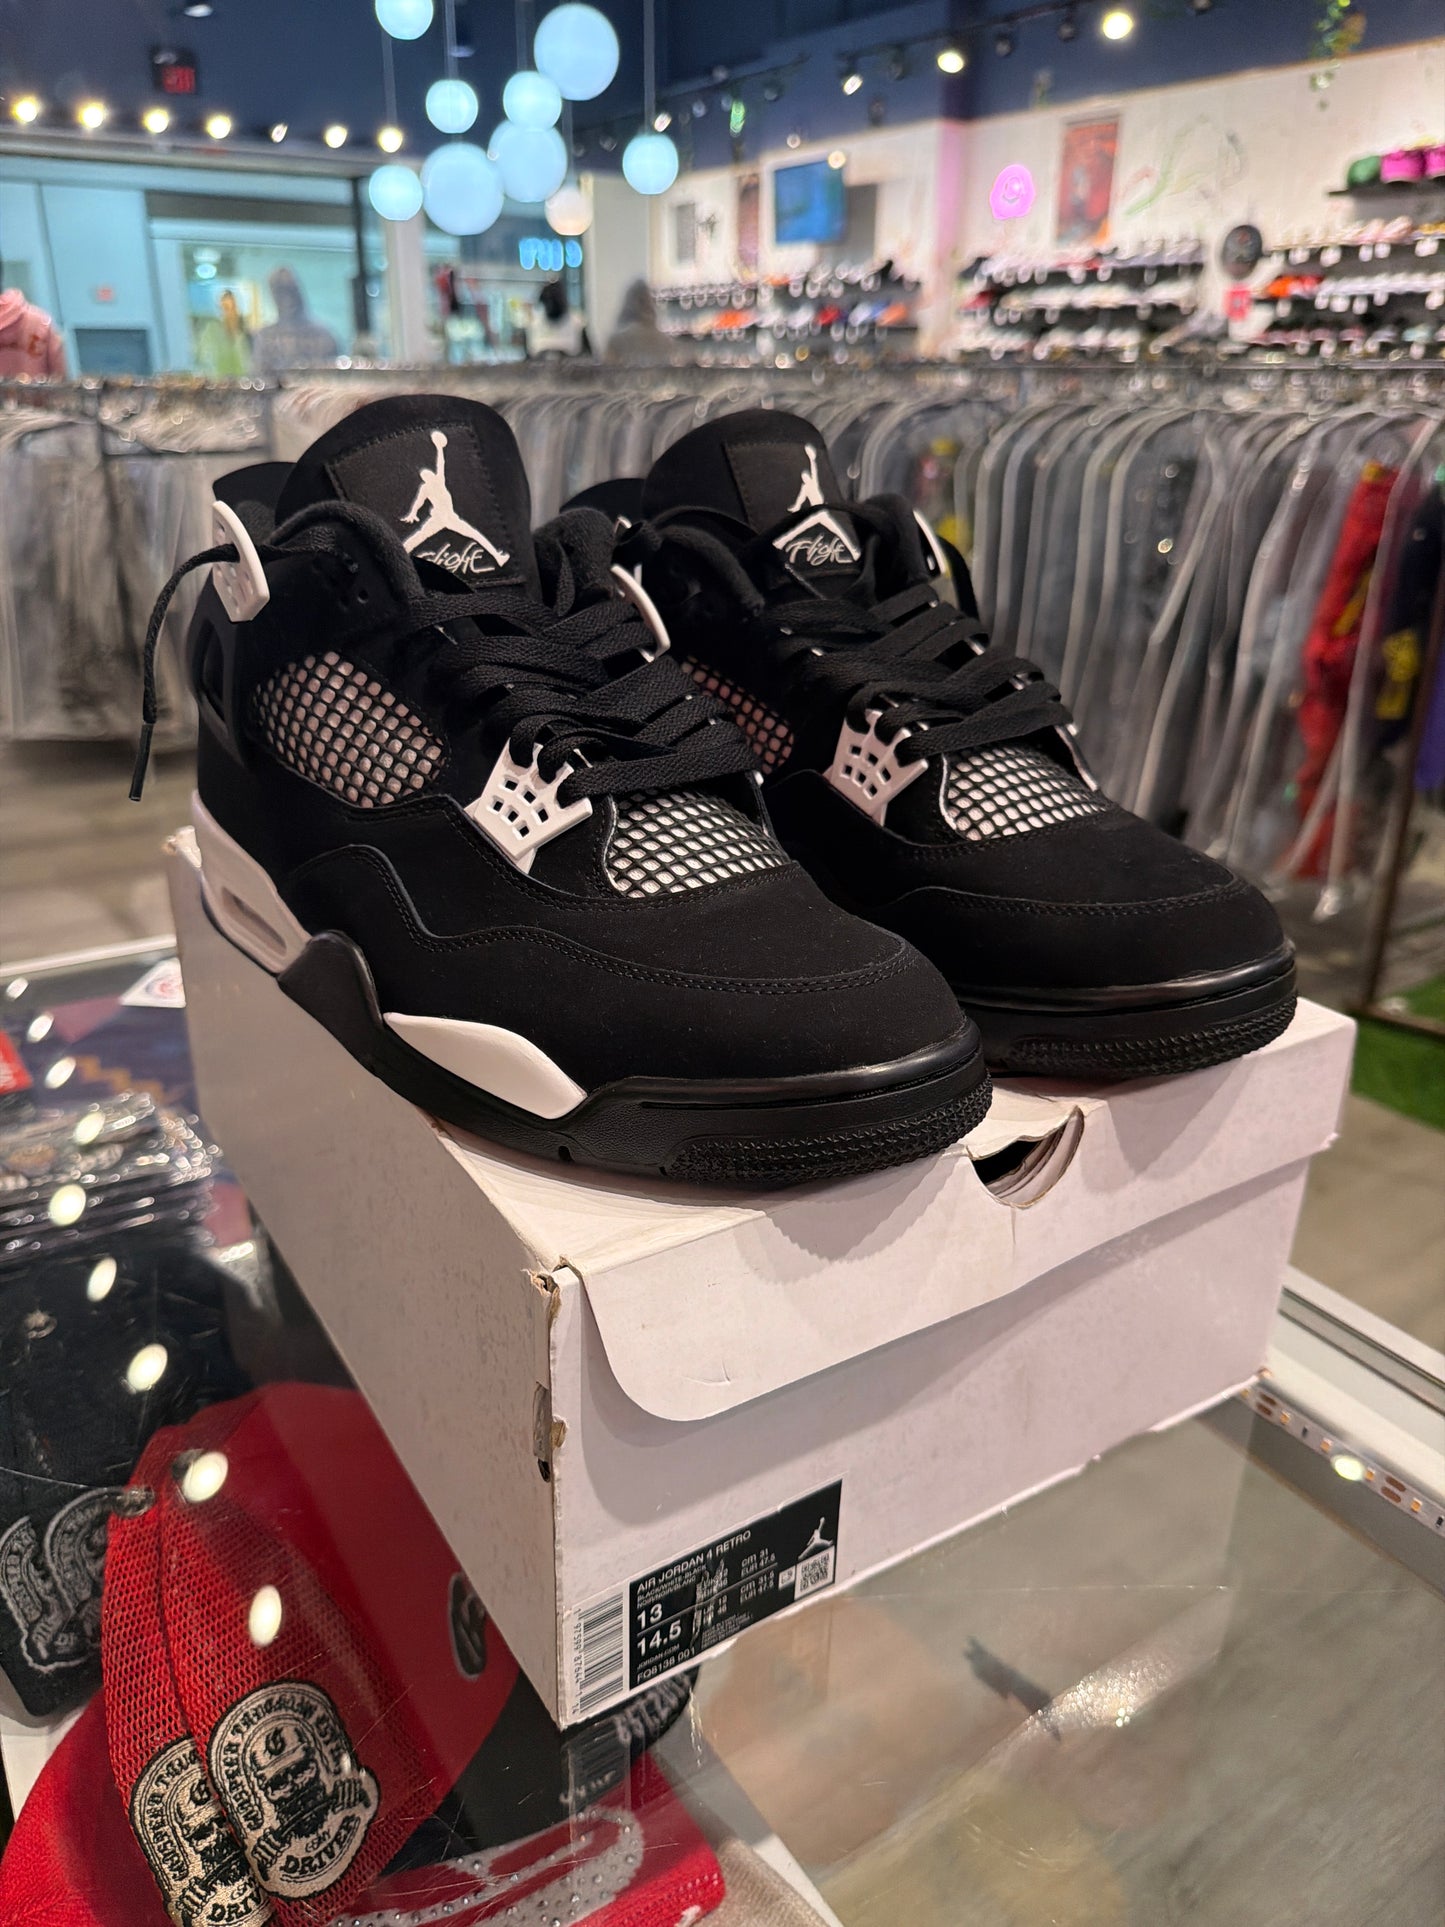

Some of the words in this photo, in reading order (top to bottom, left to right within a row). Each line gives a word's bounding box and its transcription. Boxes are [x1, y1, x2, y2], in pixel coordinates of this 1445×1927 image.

[637, 1576, 655, 1594] AIR
[658, 1552, 703, 1583] JORDAN
[706, 1548, 712, 1560] 4
[716, 1529, 750, 1555] RETRO
[741, 1553, 756, 1567] cm
[759, 1546, 768, 1559] 31
[741, 1561, 757, 1577] EUR
[740, 1579, 755, 1594] cm
[637, 1600, 662, 1631] 13
[637, 1618, 681, 1659] 14.5
[677, 1645, 694, 1663] 001
[280, 1814, 356, 1875] DRIVER
[207, 1886, 262, 1923] DRIV
